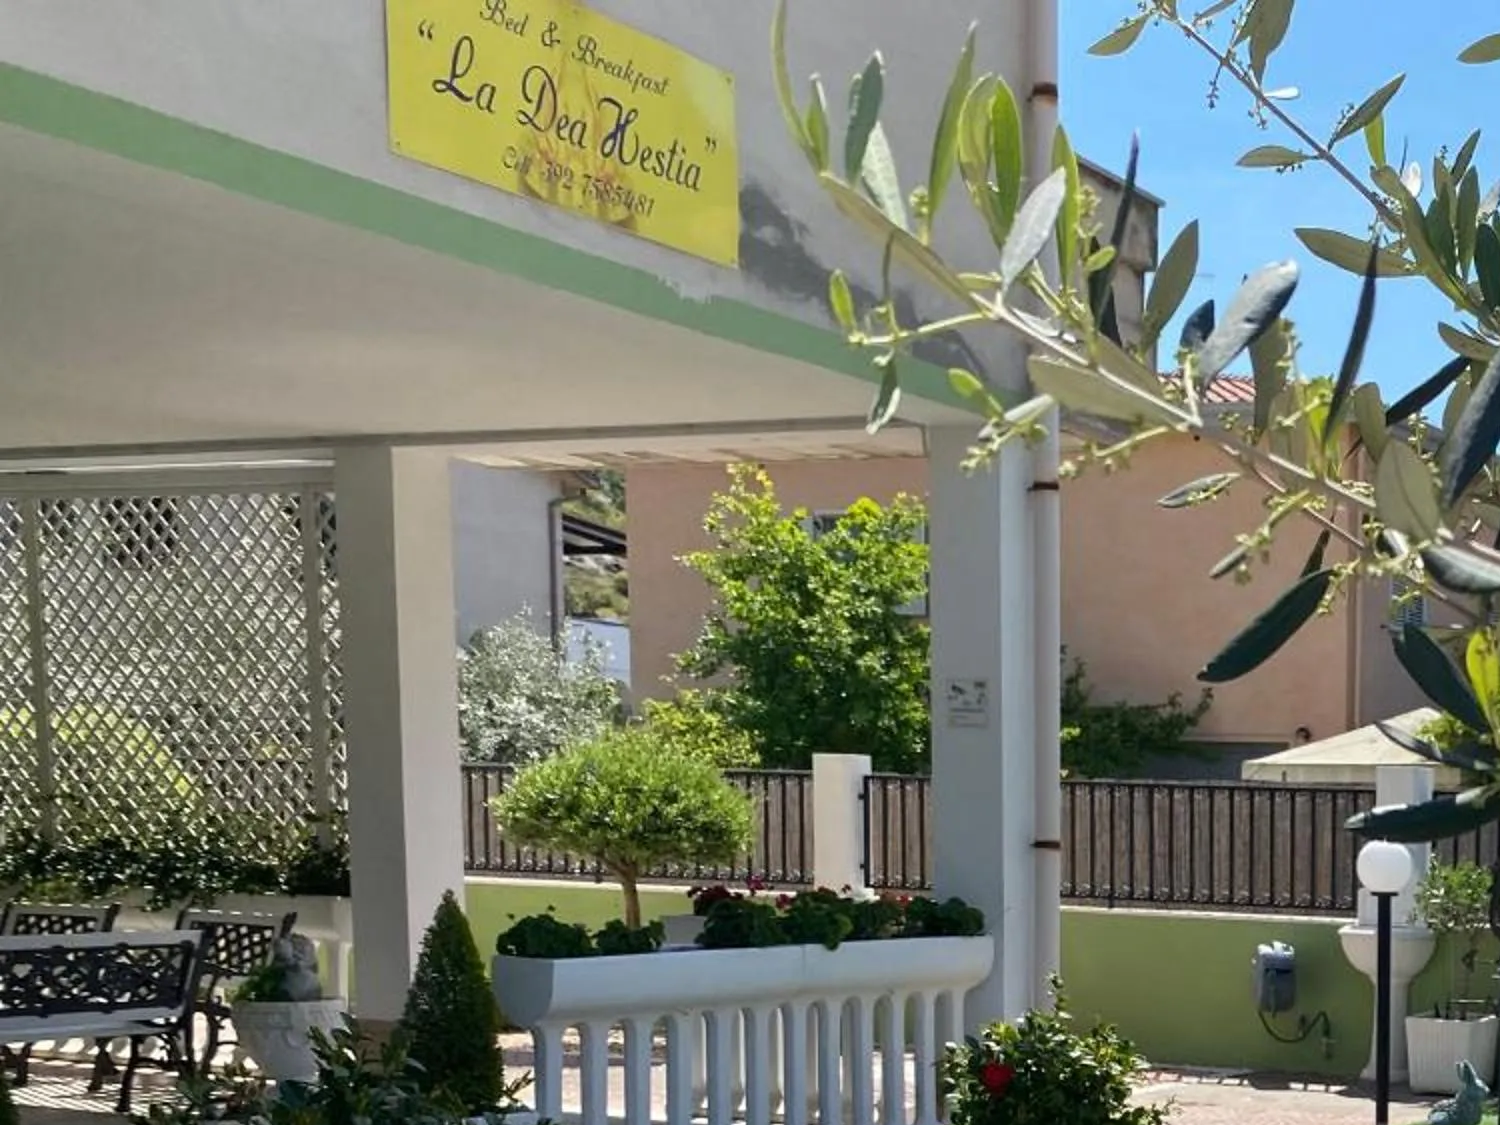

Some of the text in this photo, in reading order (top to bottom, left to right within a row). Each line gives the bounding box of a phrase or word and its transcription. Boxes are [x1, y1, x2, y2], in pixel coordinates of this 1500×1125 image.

[480, 0, 671, 96] Bed & Breakfast
[516, 65, 587, 149] Dea
